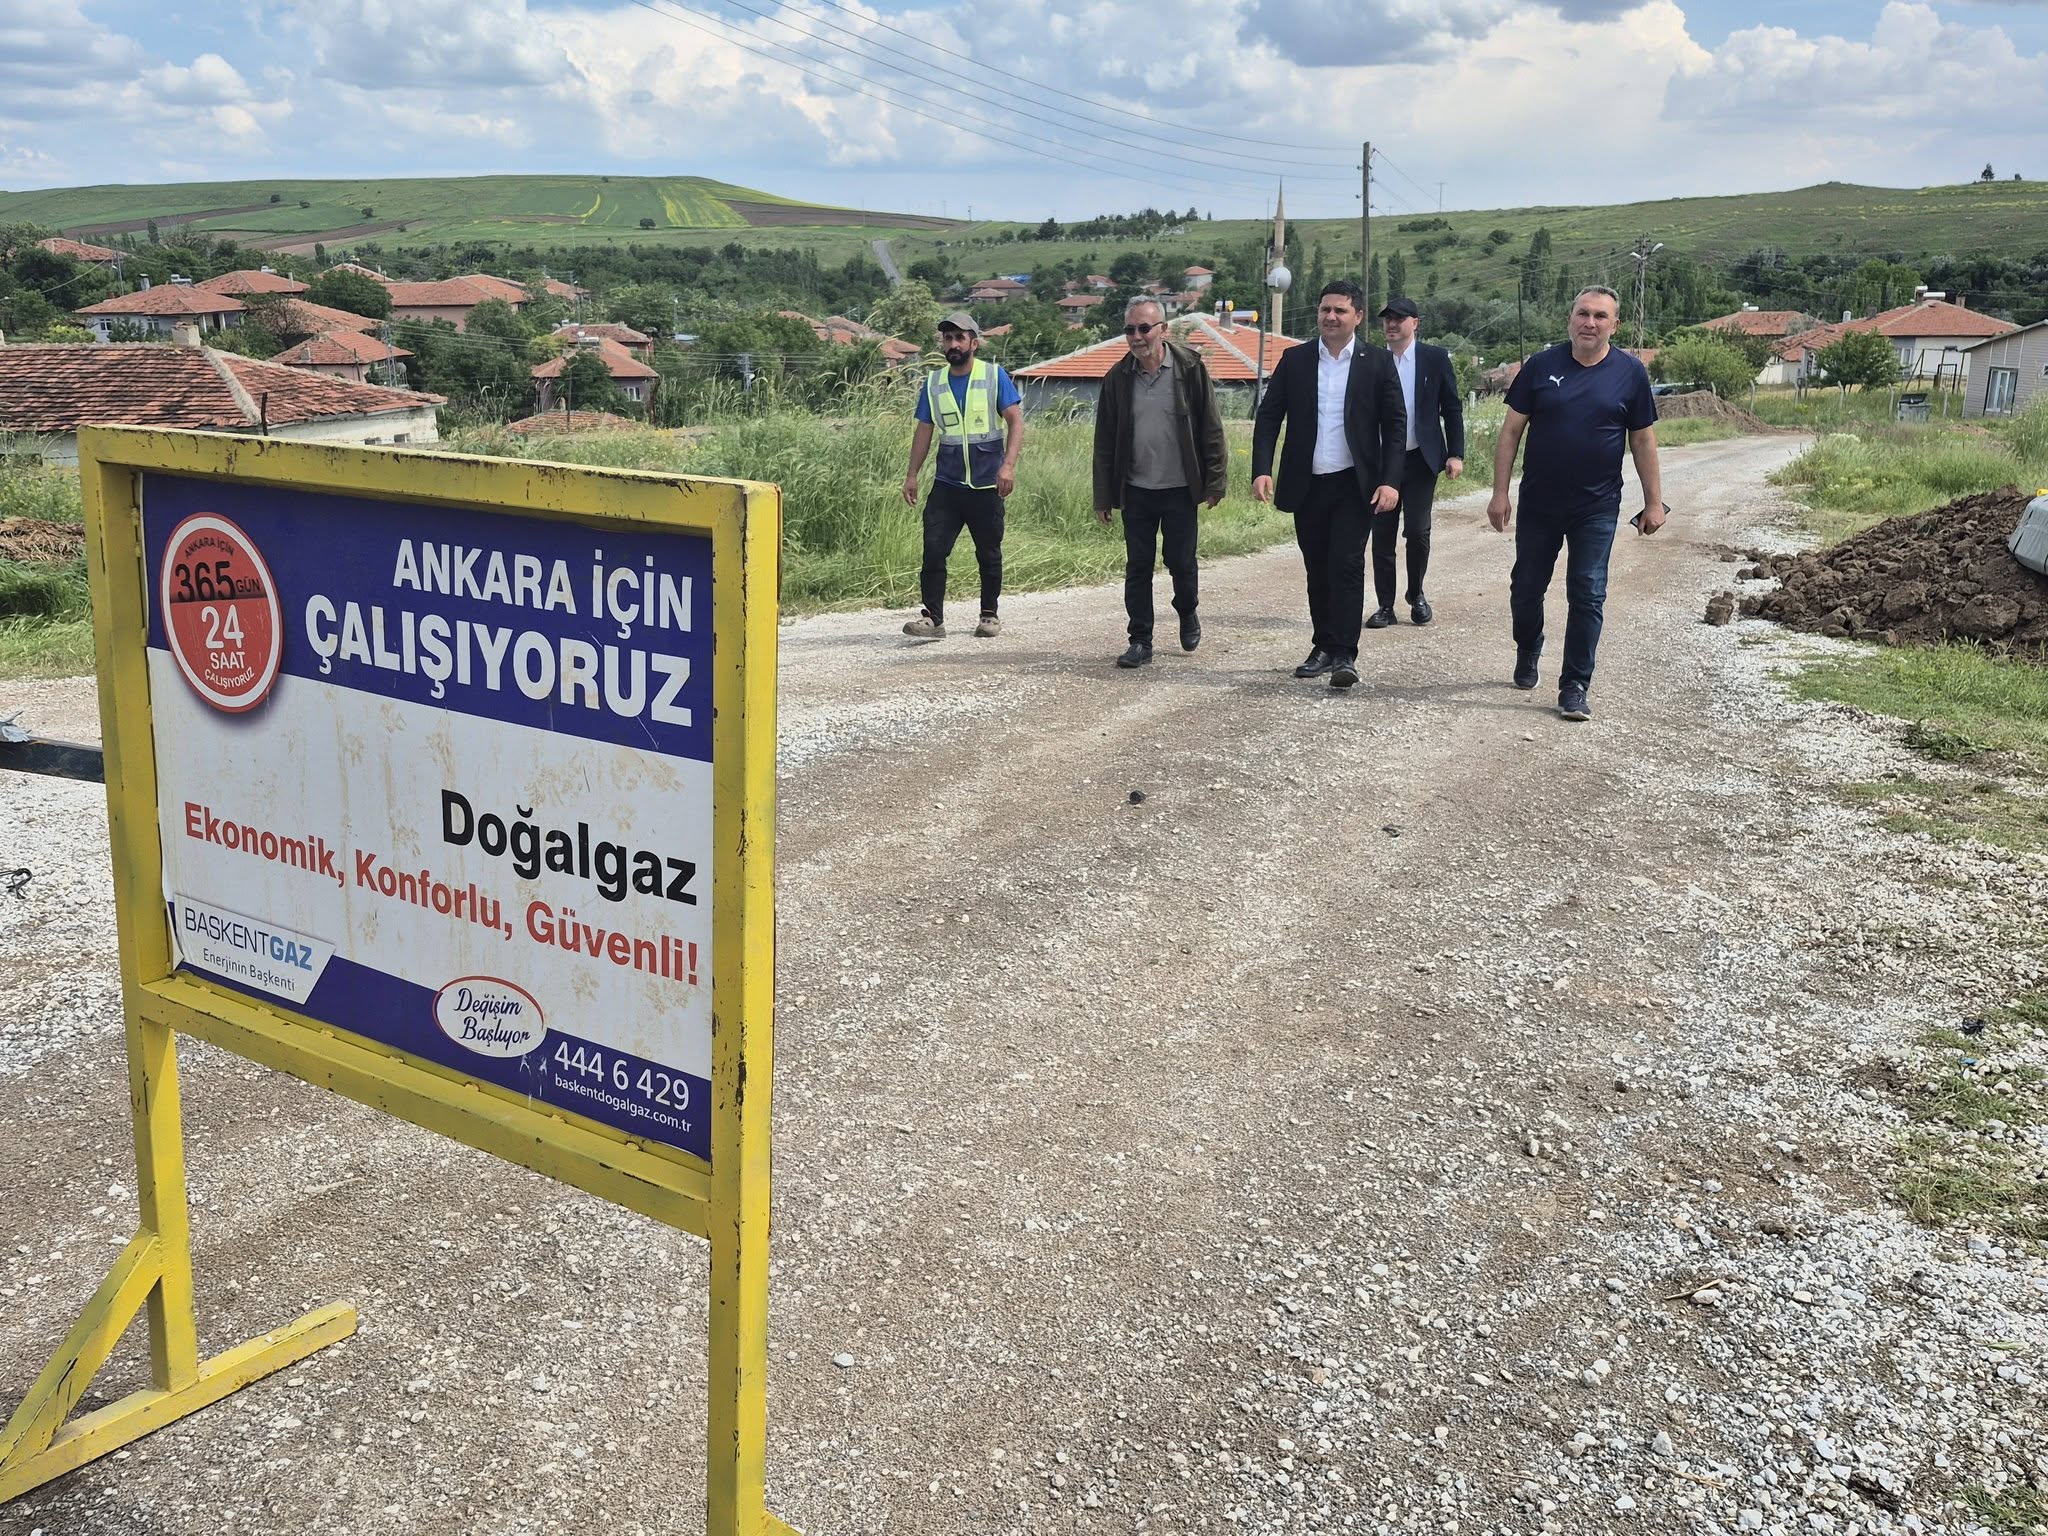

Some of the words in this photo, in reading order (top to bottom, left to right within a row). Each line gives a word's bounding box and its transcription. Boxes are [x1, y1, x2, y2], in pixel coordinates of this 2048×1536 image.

[184, 537, 215, 559] ANKARA
[216, 538, 234, 556] İÇİN
[175, 561, 236, 602] 365
[235, 576, 260, 594] GÜN
[392, 538, 577, 617] ANKARA
[592, 549, 693, 640] İÇİN
[201, 604, 245, 649] 24
[204, 666, 255, 690] ÇALIŞIYORUZ
[210, 651, 246, 670] SAAT
[305, 594, 692, 728] ÇALIŞIYORUZ
[441, 788, 698, 906] Doğalgaz
[184, 801, 346, 888] Ekonomik,
[355, 849, 513, 942] Konforlu,
[526, 900, 700, 985] Güvenli!
[185, 907, 313, 971] BAŞKENTGAZ
[203, 948, 247, 975] Enerjinin
[250, 965, 295, 991] Başkenti
[453, 987, 523, 1020] Değişim
[458, 1016, 531, 1050] Başlıyor
[554, 1041, 605, 1082] 444
[612, 1059, 629, 1090] 6
[636, 1068, 690, 1111] 429
[555, 1073, 692, 1133] baskentdogalgaz.com.tr
